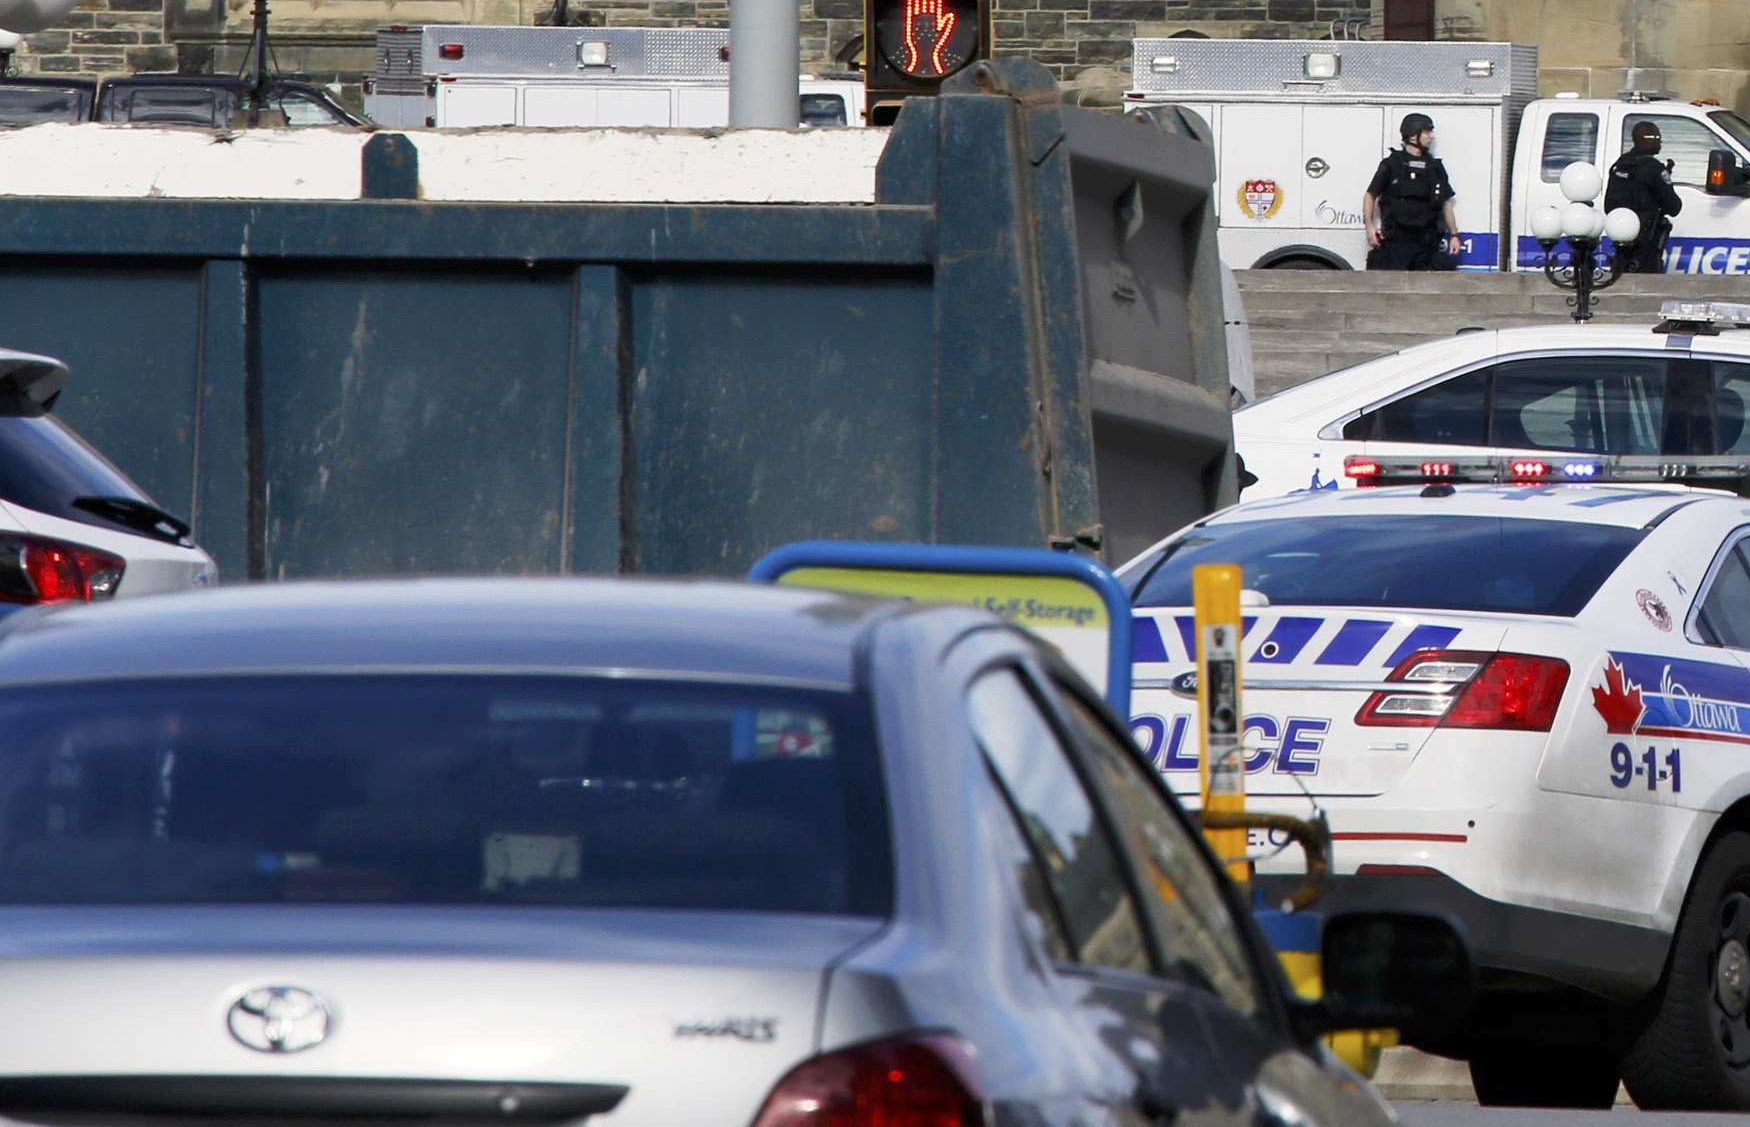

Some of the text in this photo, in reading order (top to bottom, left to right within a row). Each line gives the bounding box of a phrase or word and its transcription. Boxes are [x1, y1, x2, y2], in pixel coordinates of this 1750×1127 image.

[1658, 664, 1742, 732] Ottawa
[1128, 713, 1332, 776] OLCE
[1610, 742, 1681, 792] 9-1-1
